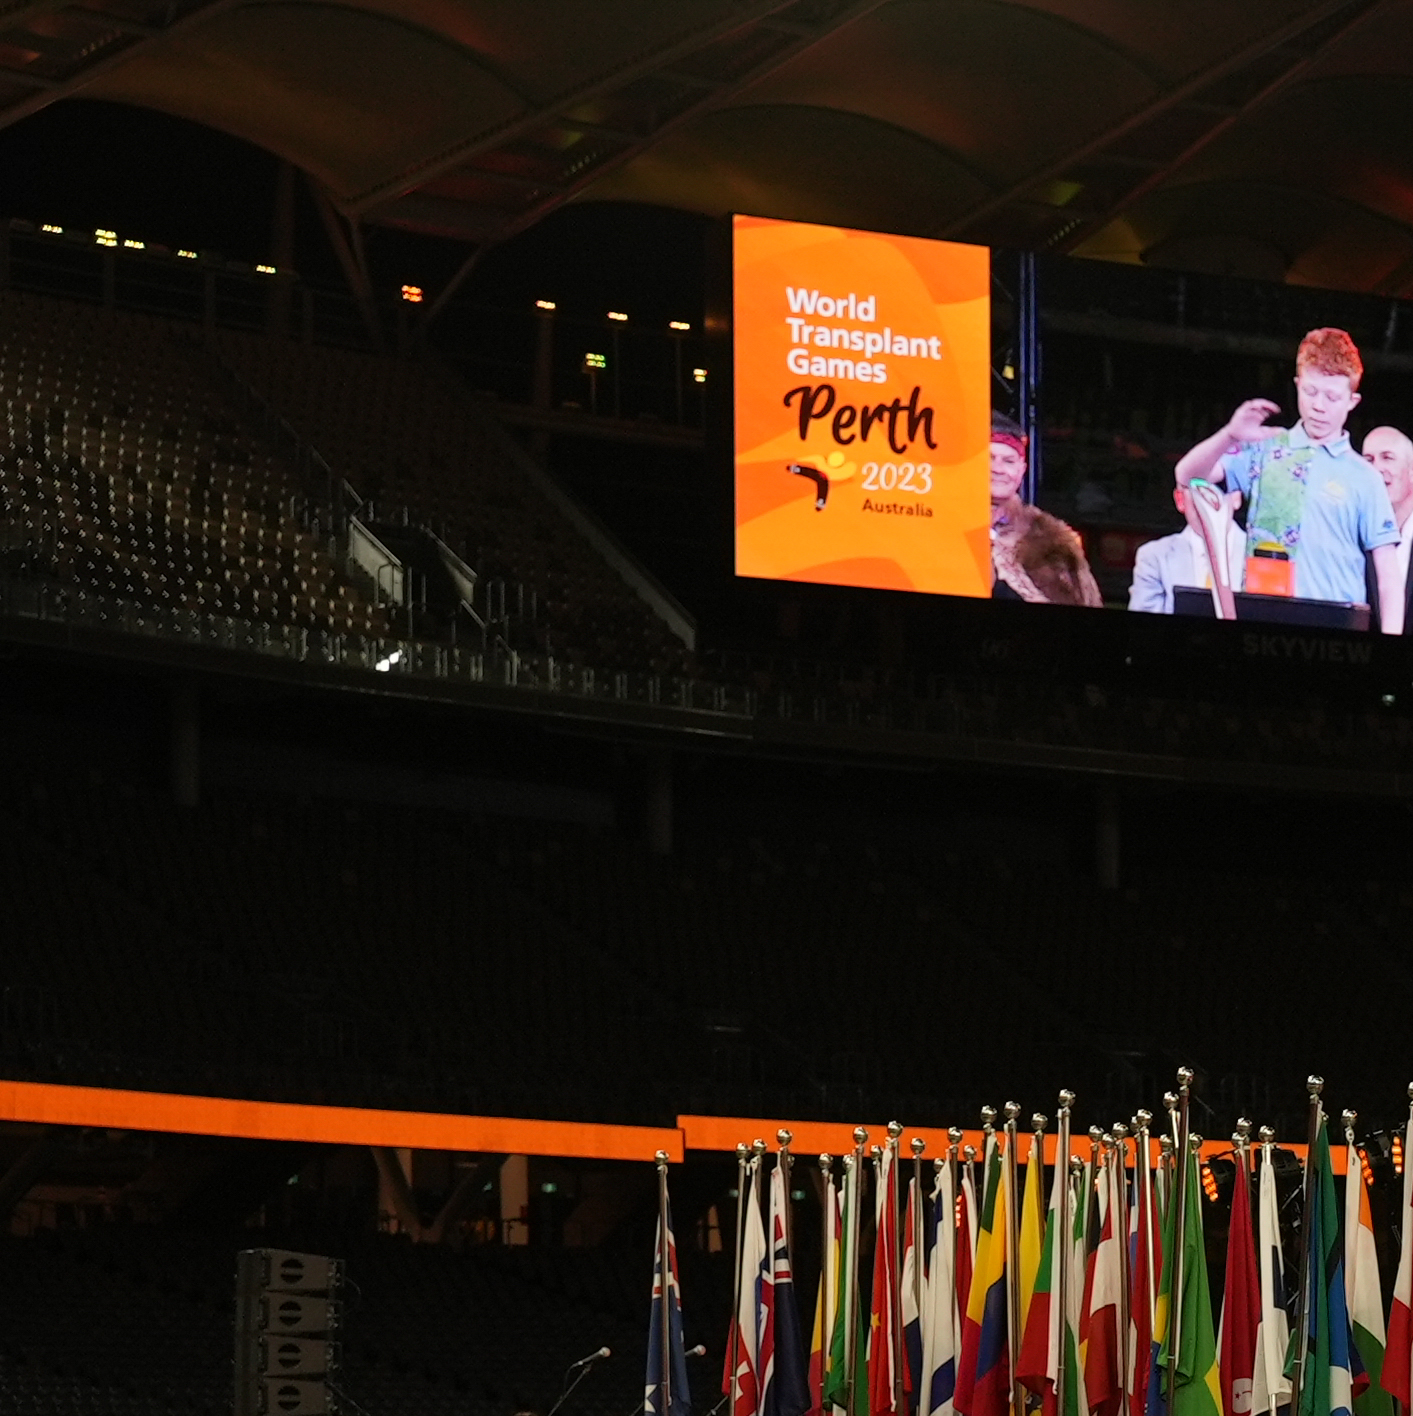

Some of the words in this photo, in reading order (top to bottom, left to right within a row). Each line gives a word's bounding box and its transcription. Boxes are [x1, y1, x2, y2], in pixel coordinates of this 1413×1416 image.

[785, 286, 876, 322] World
[785, 317, 942, 360] Transplant
[786, 348, 887, 384] Games
[783, 384, 937, 454] Perth
[861, 461, 933, 494] 2023
[862, 498, 933, 518] Australia
[1243, 633, 1373, 664] SKYVIEW
